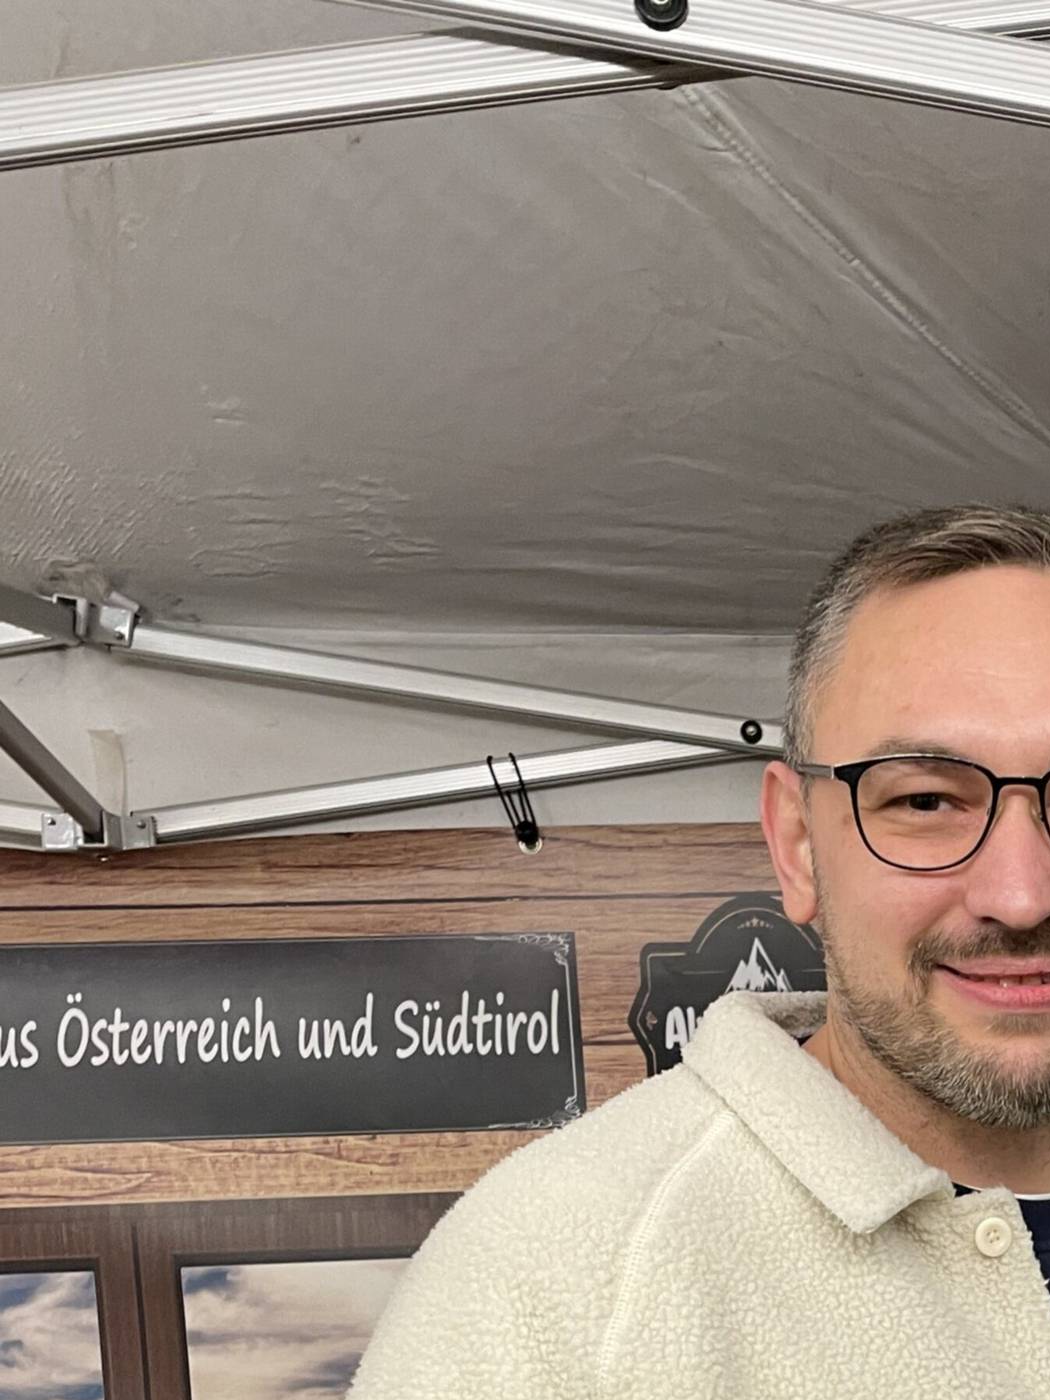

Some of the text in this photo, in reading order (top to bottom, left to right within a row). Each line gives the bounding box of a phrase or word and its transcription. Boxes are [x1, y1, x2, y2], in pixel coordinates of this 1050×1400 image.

[0, 988, 560, 1068] us Österreich und Südtirol
